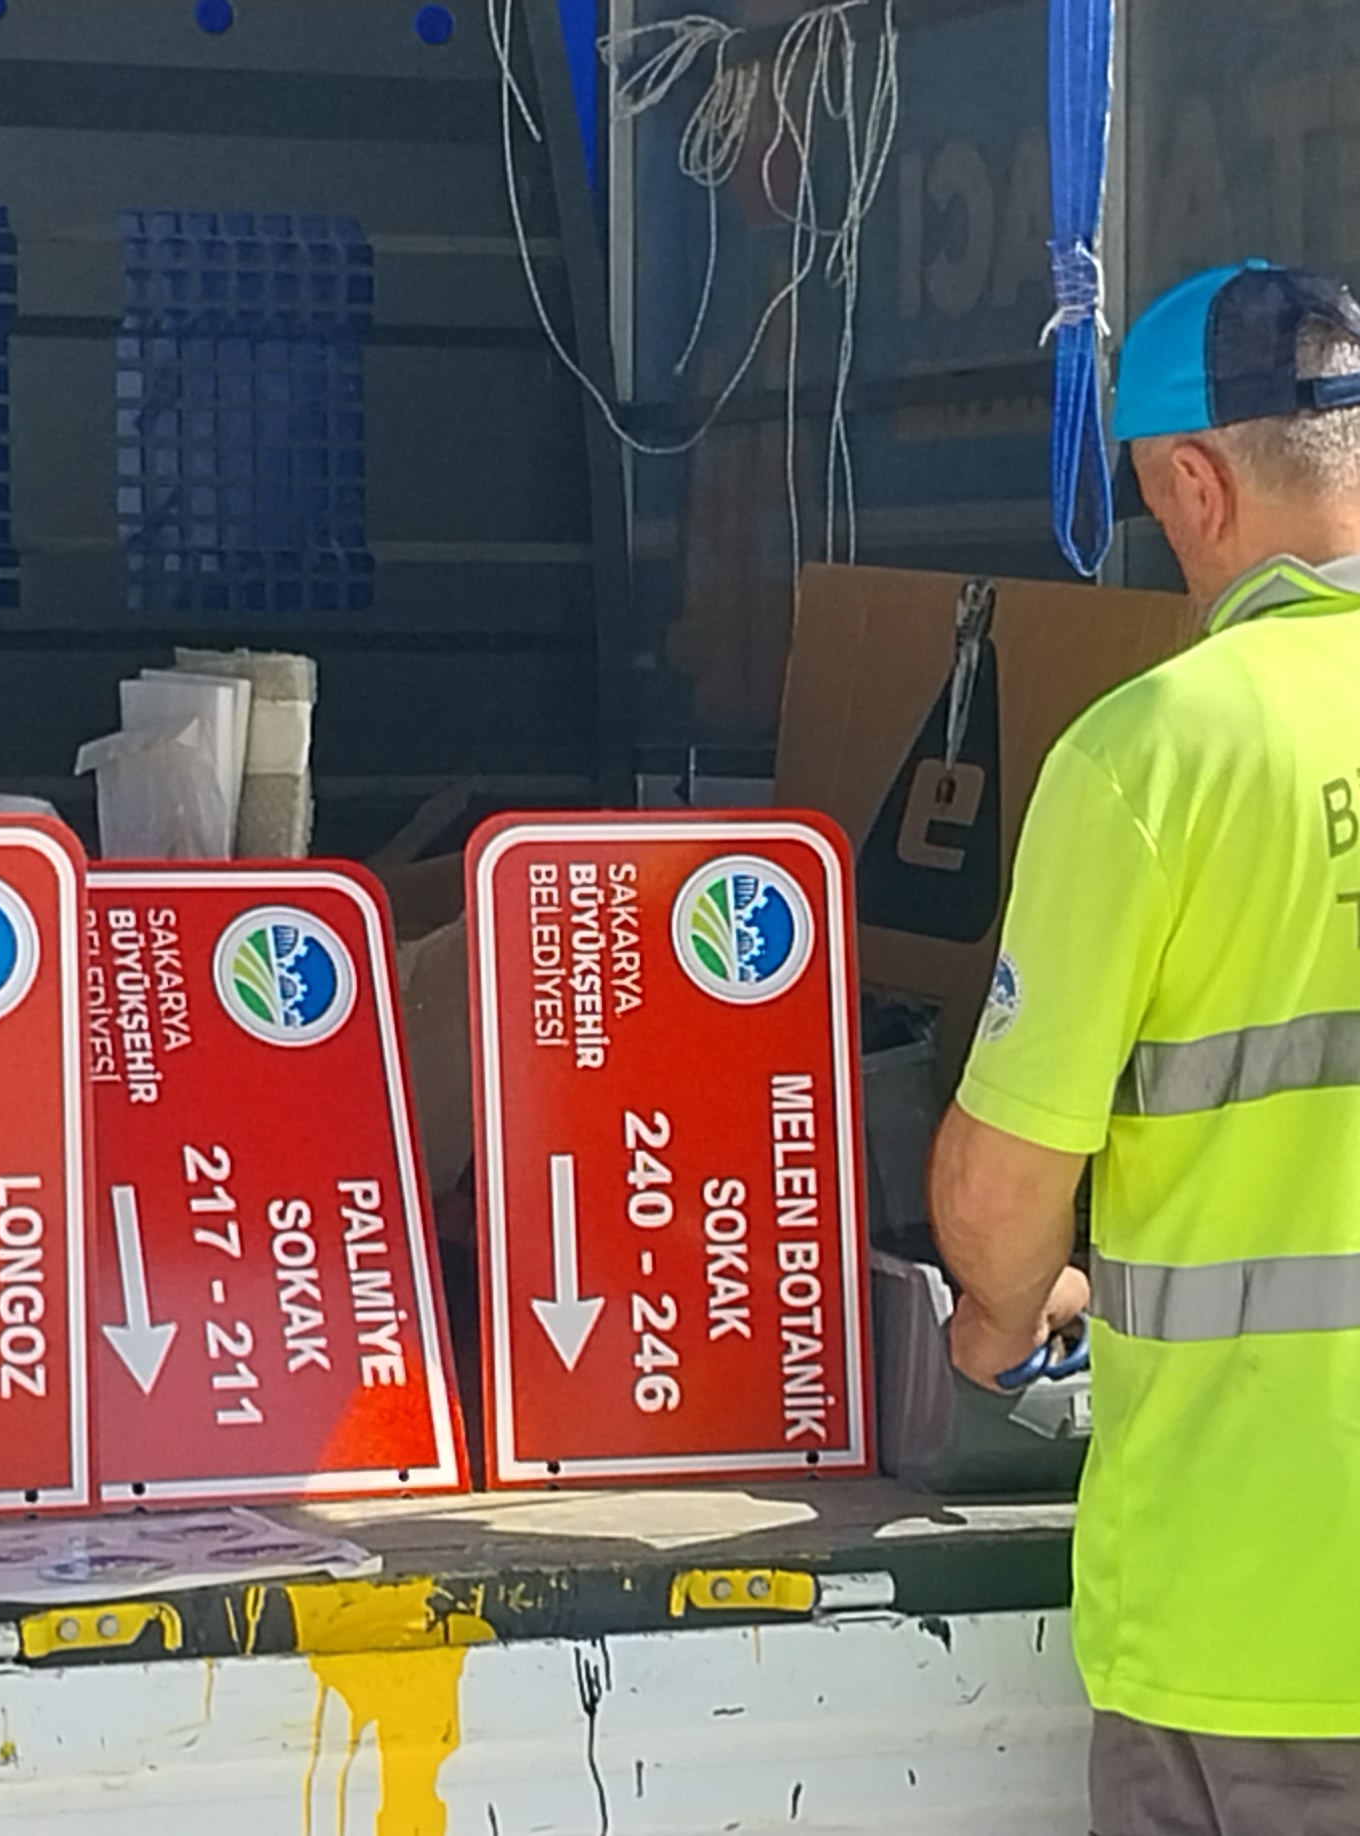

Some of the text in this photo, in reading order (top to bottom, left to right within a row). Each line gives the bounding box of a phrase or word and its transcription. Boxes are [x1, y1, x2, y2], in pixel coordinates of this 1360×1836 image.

[107, 908, 164, 1104] BÜYÜKŞEHİR
[147, 907, 192, 1051] SAKARYA
[529, 863, 570, 1046] BELEDİYESİ
[568, 863, 610, 1068] BÜYÜKŞEHİR
[607, 863, 642, 1019] SAKARYA
[182, 1144, 264, 1425] 217 - 211
[267, 1199, 331, 1373] SOKAK
[337, 1180, 408, 1388] PALMİYE
[624, 1109, 682, 1414] 240 - 246
[703, 1178, 752, 1342] SOKAK
[771, 1074, 836, 1443] MELEN BOTANİK
